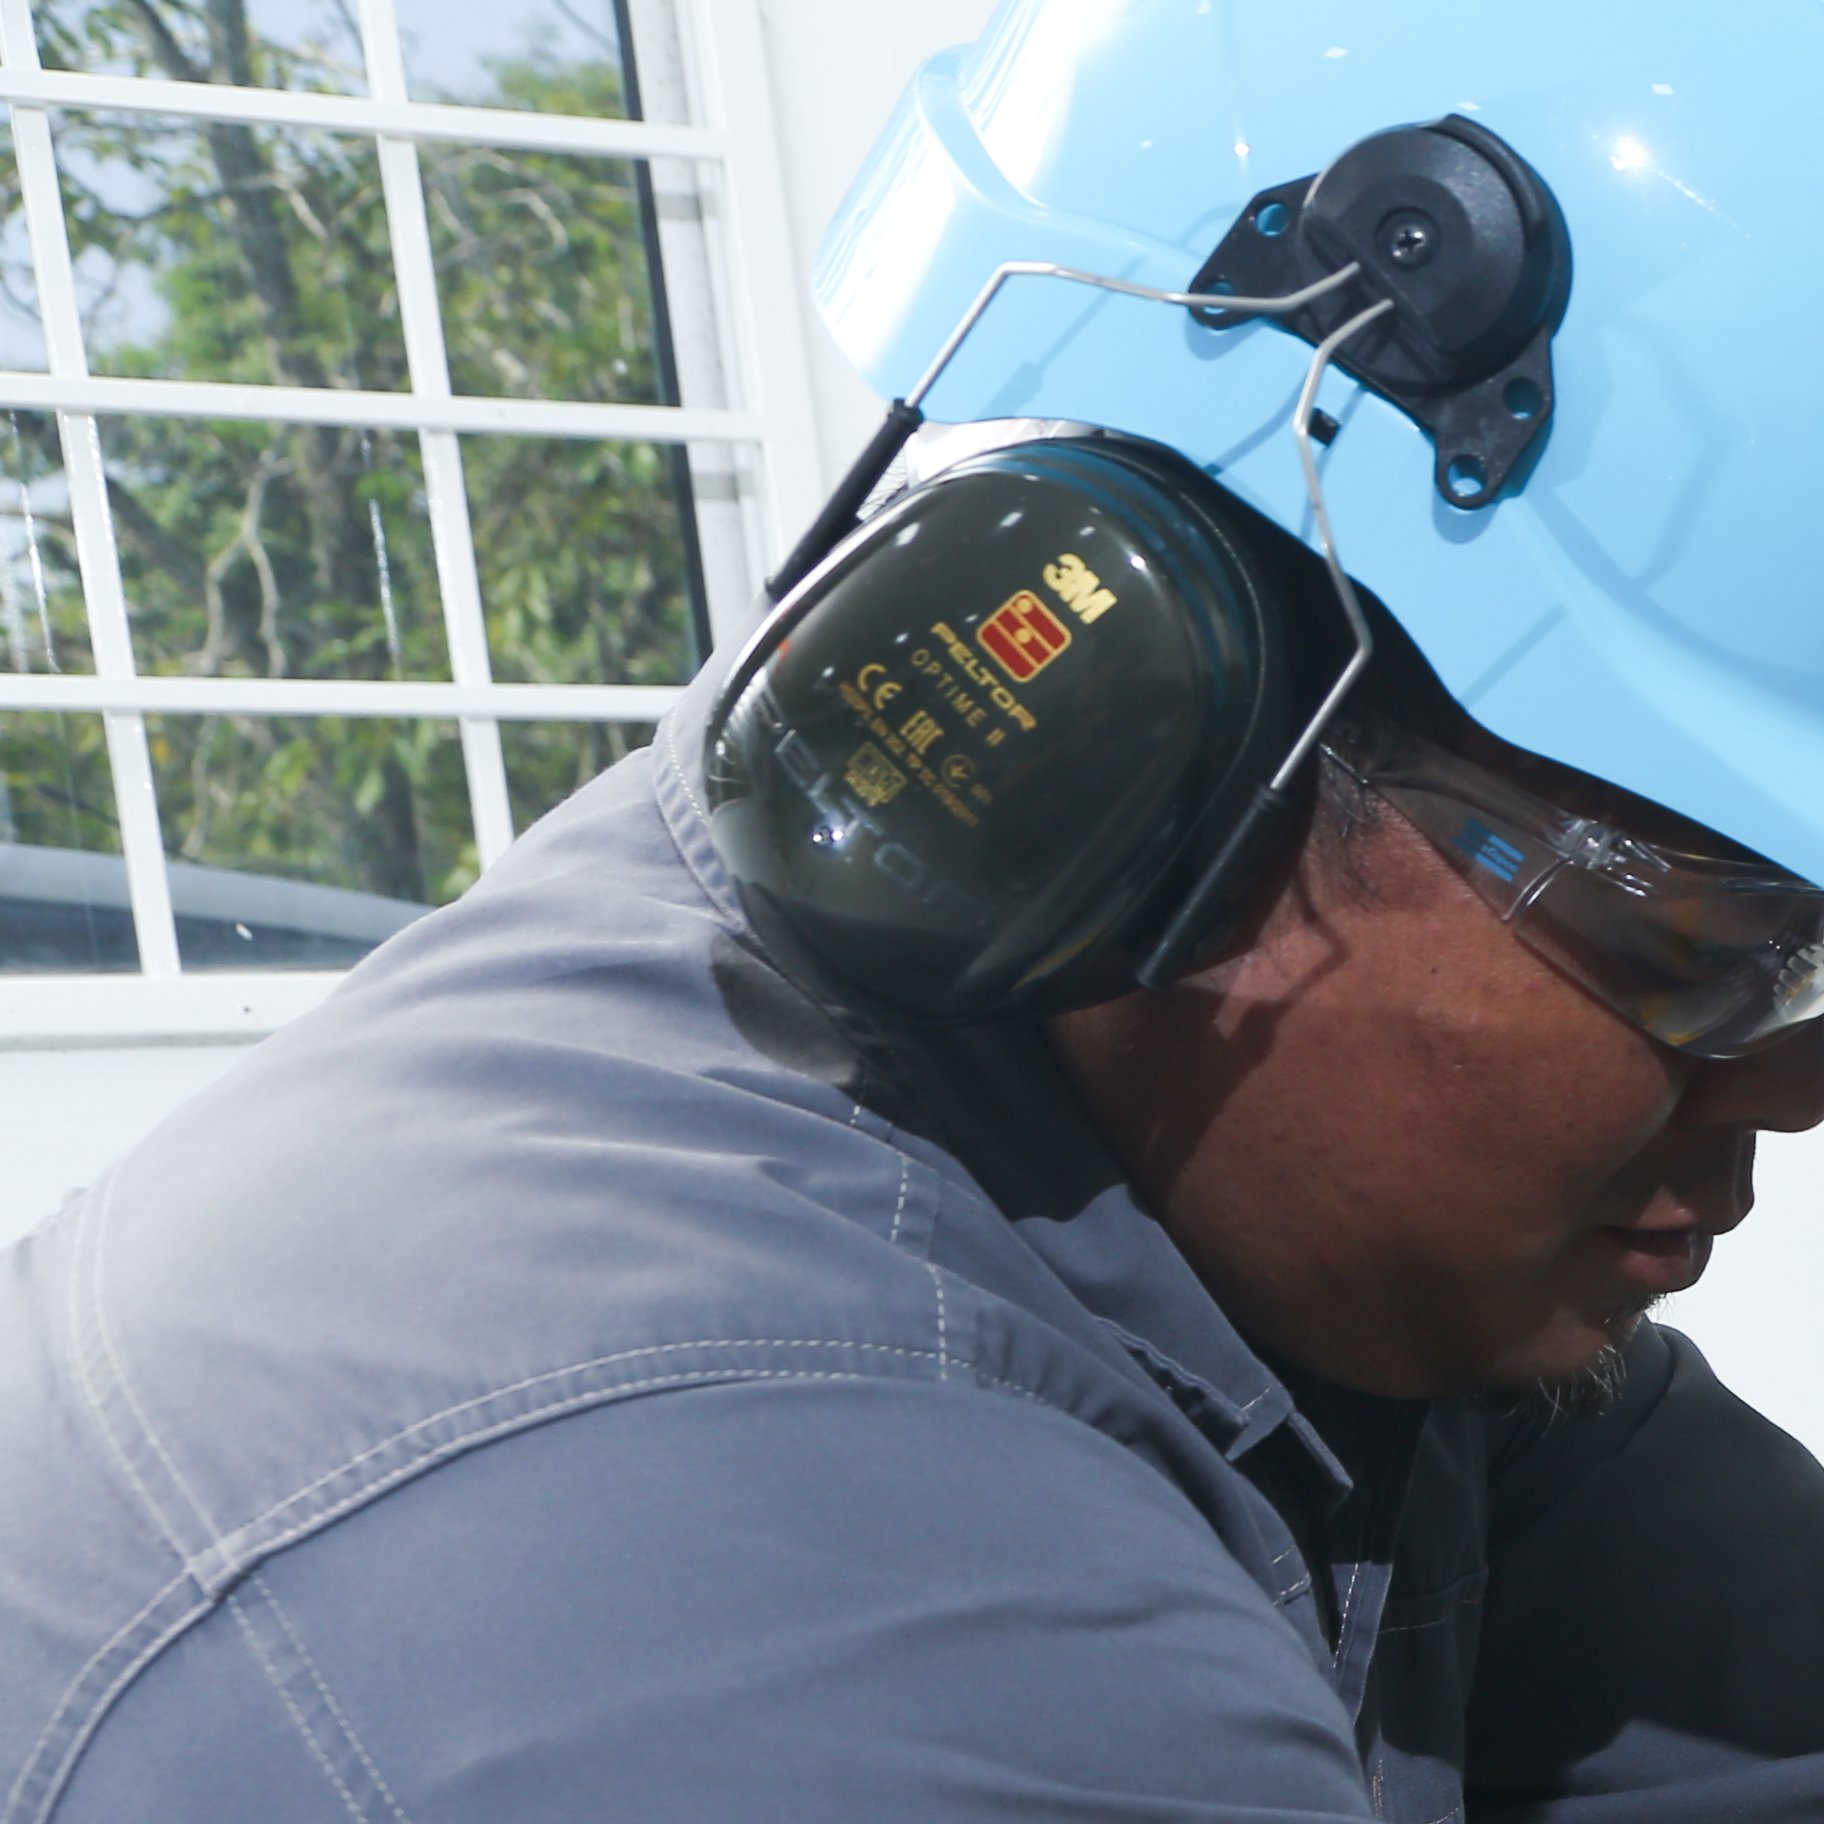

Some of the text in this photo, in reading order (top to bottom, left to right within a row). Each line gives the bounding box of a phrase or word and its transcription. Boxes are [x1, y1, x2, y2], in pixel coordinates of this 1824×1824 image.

[1042, 553, 1118, 624] 3M
[911, 648, 988, 727] OPTIME
[929, 621, 1037, 734] PELTOR
